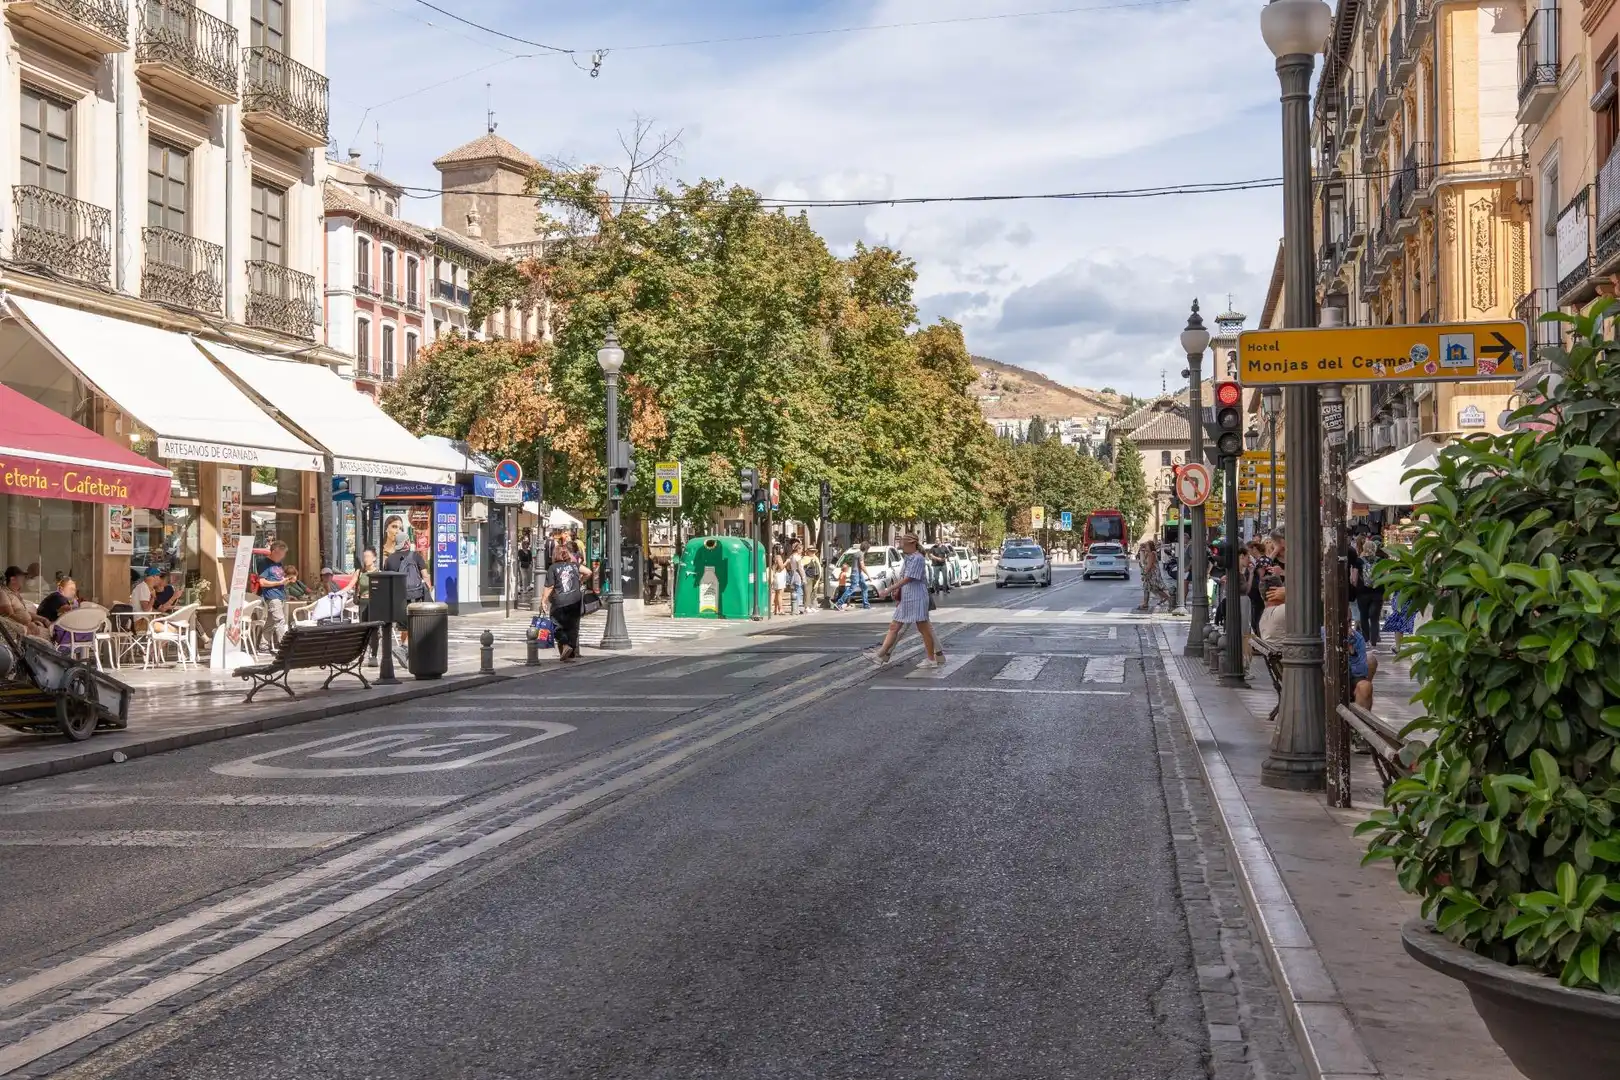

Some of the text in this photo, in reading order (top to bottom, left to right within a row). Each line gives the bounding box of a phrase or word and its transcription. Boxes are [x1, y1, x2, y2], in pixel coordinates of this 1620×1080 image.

[1248, 341, 1280, 351] Hotel
[1248, 358, 1308, 373] Monjas
[1317, 357, 1342, 370] del
[164, 442, 259, 462] ARTESANOS DE GRANADA
[340, 461, 372, 473] ARTESANOS
[382, 465, 408, 476] GRANADA
[64, 472, 128, 498] Cafetería
